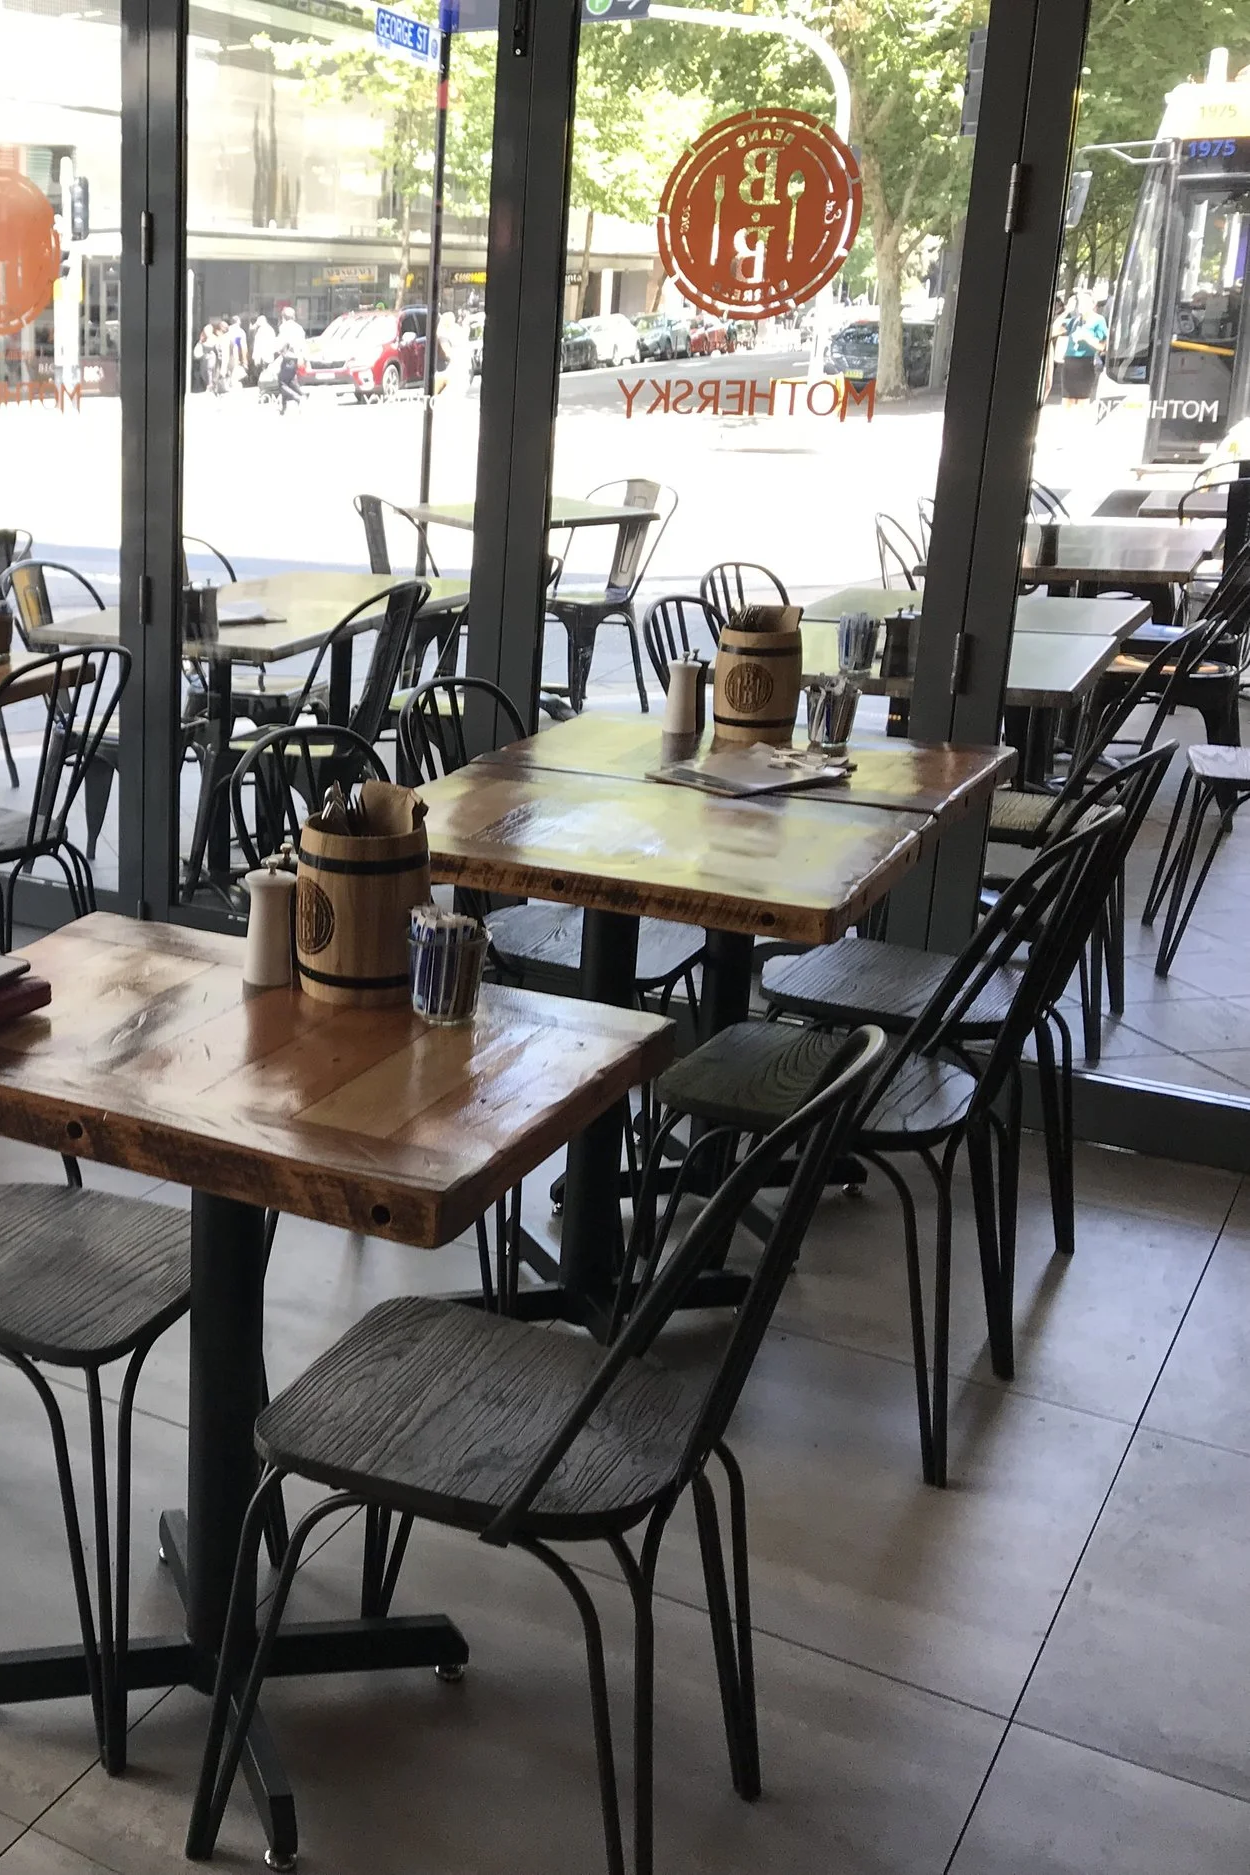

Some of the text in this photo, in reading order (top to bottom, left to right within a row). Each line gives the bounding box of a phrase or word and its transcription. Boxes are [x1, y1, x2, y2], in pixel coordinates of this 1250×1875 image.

[378, 11, 414, 47] GEORGE
[416, 26, 428, 52] ST
[1188, 139, 1236, 158] 1975
